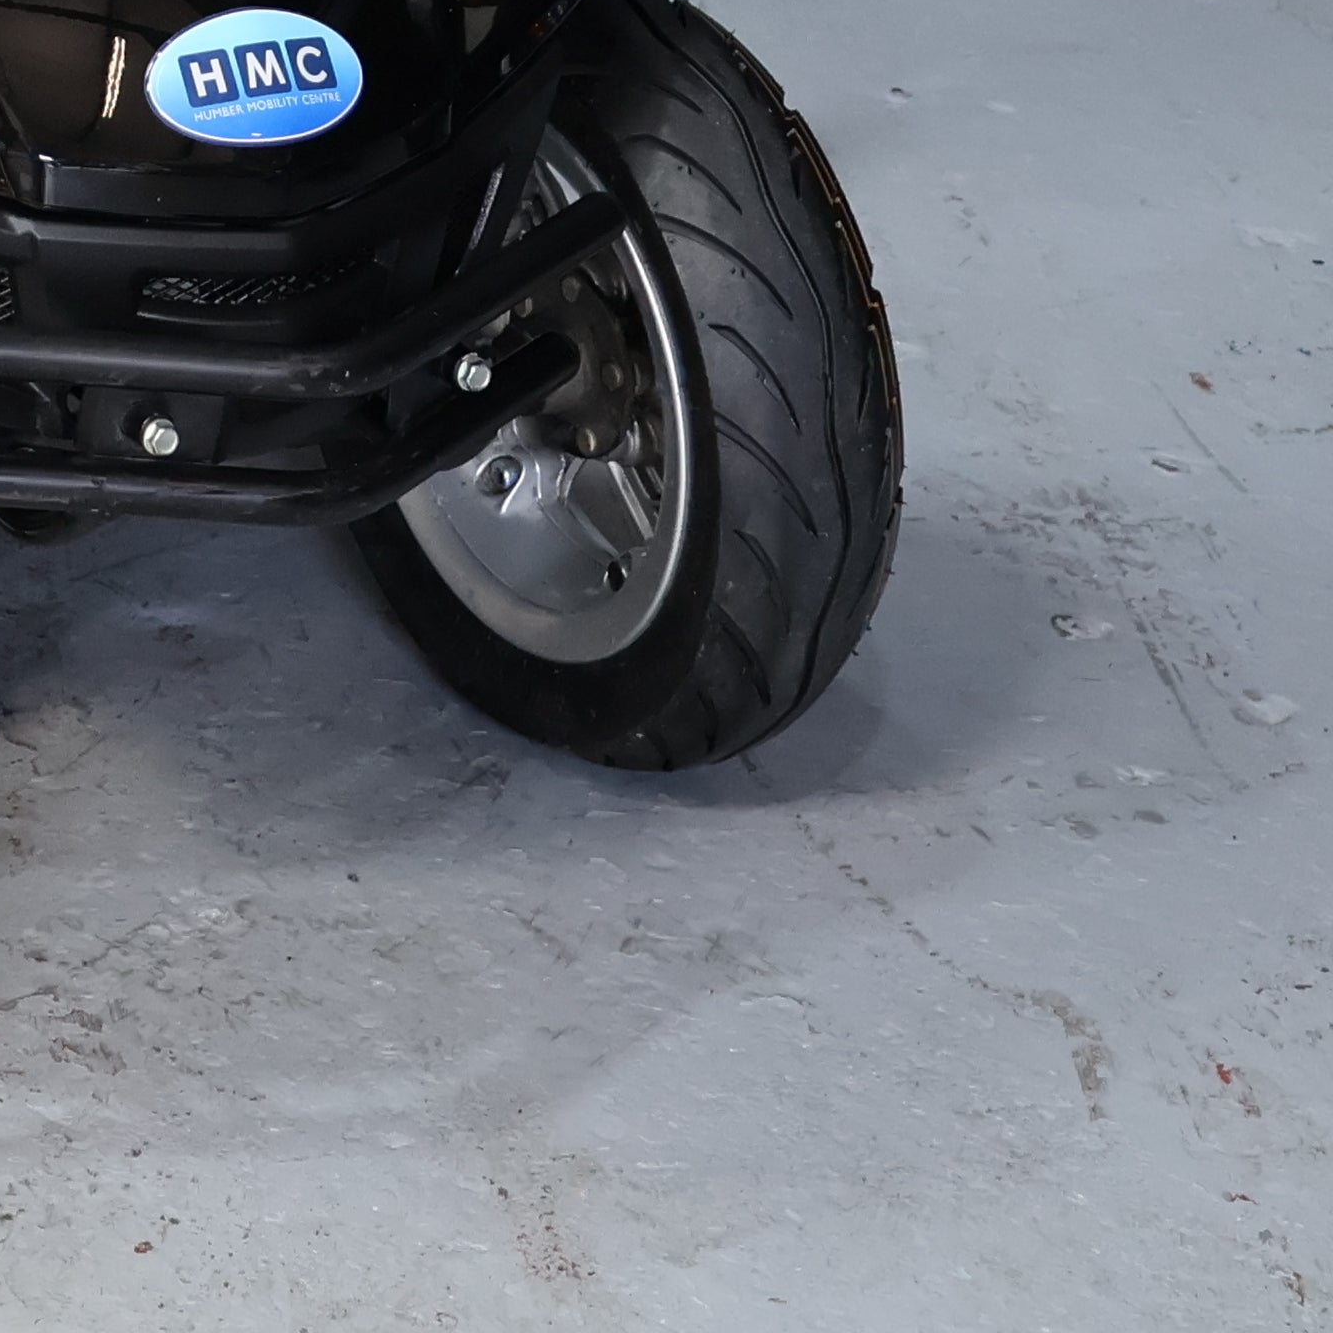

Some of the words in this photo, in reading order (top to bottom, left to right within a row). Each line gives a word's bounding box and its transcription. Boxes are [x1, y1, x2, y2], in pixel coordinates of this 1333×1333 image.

[188, 44, 329, 98] HMC
[193, 104, 244, 122] HUMBER
[247, 96, 299, 113] MOBILITY
[301, 90, 342, 105] CENTRE
